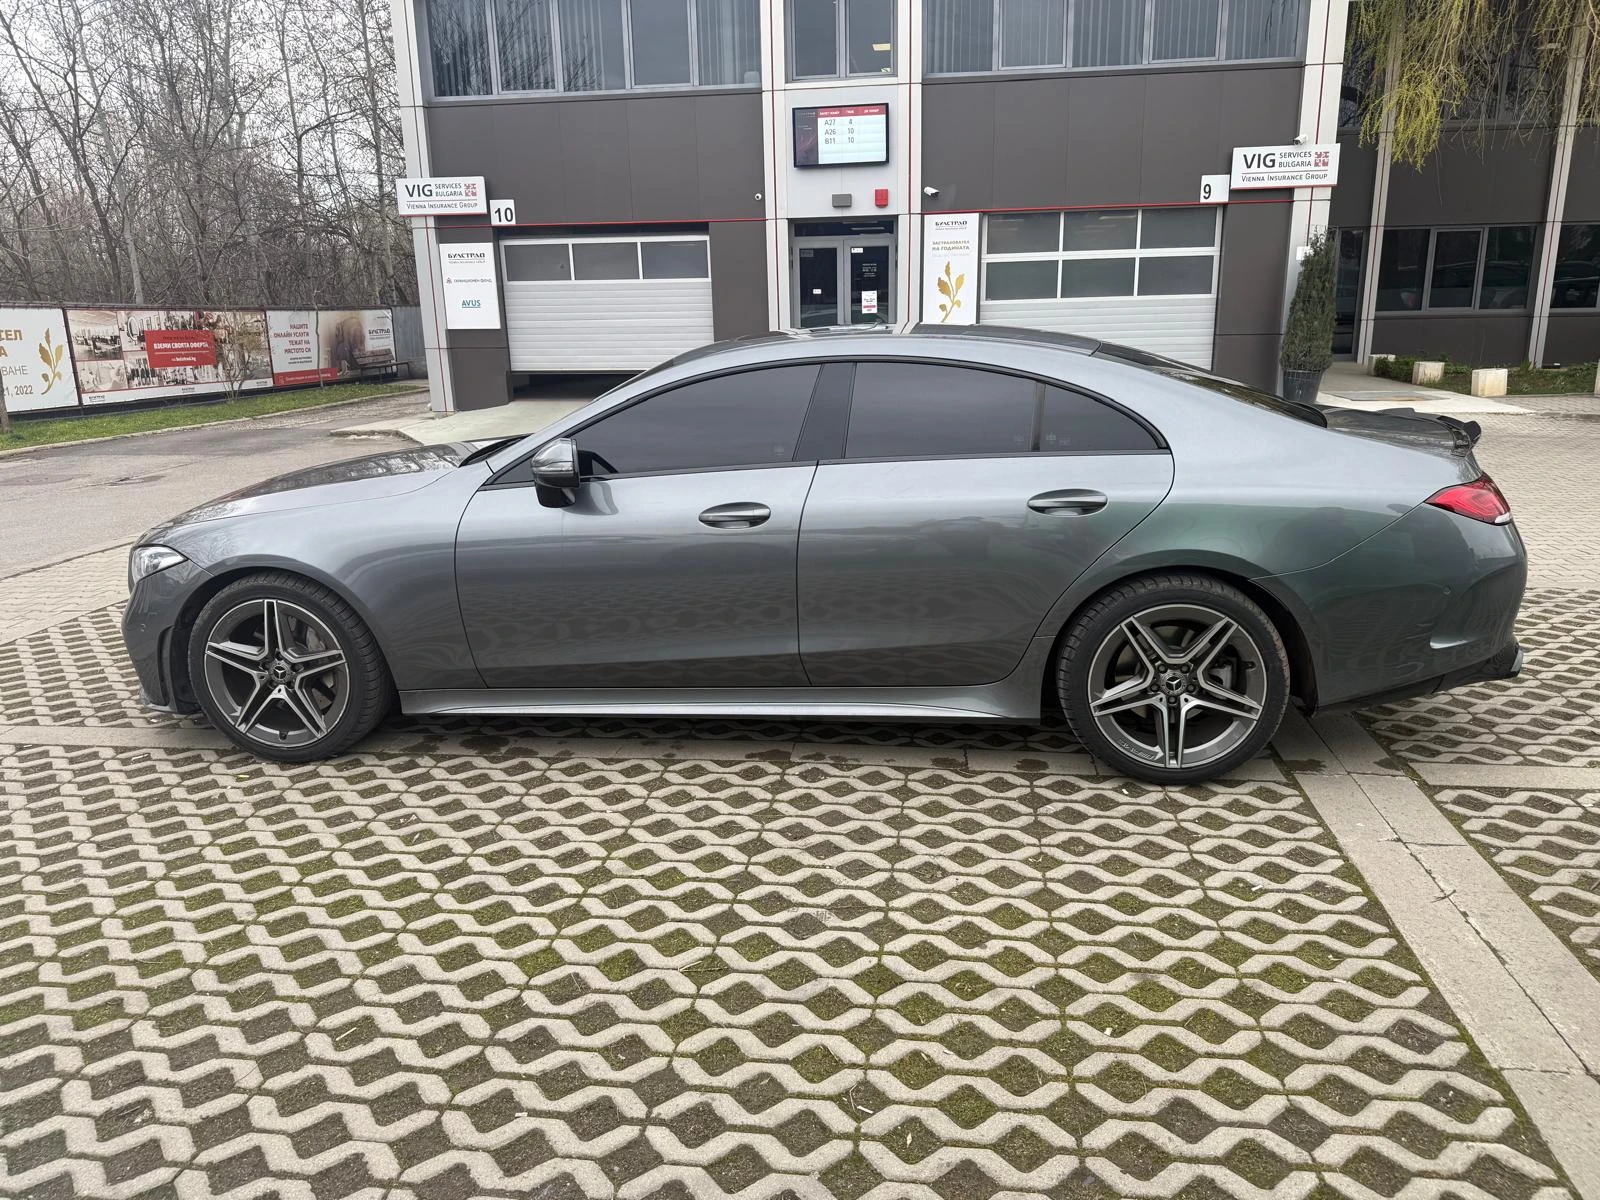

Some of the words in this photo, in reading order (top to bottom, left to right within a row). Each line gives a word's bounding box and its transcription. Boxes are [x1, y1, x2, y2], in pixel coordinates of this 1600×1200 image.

[847, 127, 855, 135] 10
[847, 136, 855, 144] 10
[1279, 151, 1312, 159] SERVICES
[1243, 153, 1276, 169] VIG
[1278, 160, 1312, 168] BULGARIA
[405, 183, 433, 198] VIG
[435, 190, 464, 198] BULGARIA
[1202, 183, 1212, 200] 9
[494, 207, 514, 223] 10
[15, 384, 34, 396] 2022
